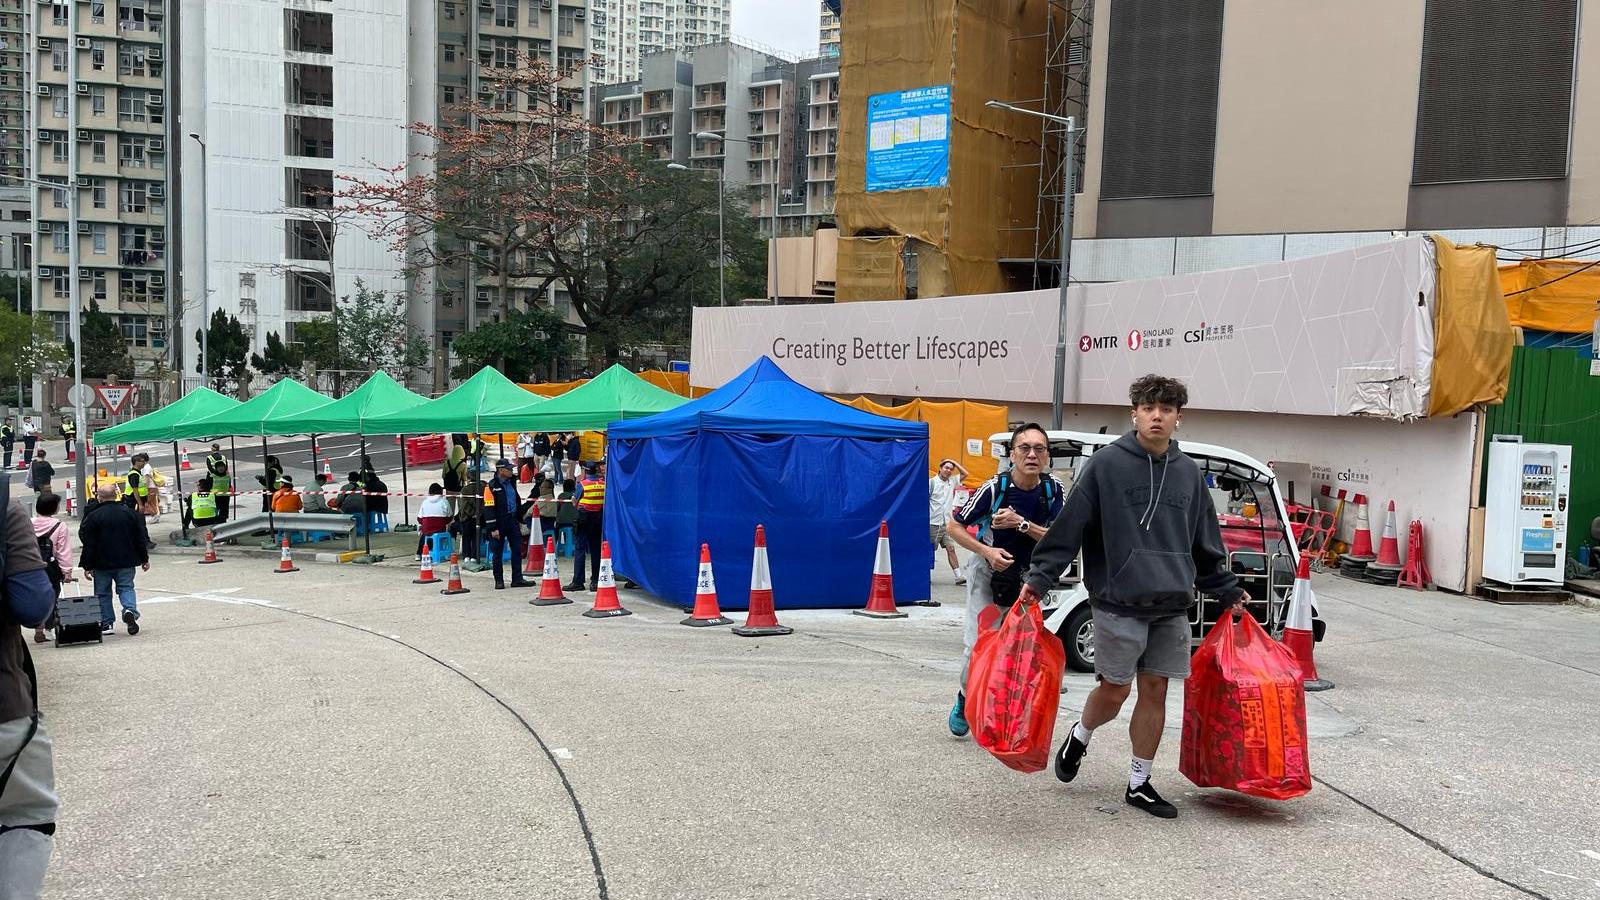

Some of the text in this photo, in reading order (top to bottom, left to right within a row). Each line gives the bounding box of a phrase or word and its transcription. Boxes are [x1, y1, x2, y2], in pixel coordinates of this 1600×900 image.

[1142, 327, 1174, 338] SINO LAND
[1092, 335, 1118, 349] MTR
[1142, 338, 1172, 349] 信和置業
[772, 335, 1009, 367] Creating Better Lifescapes
